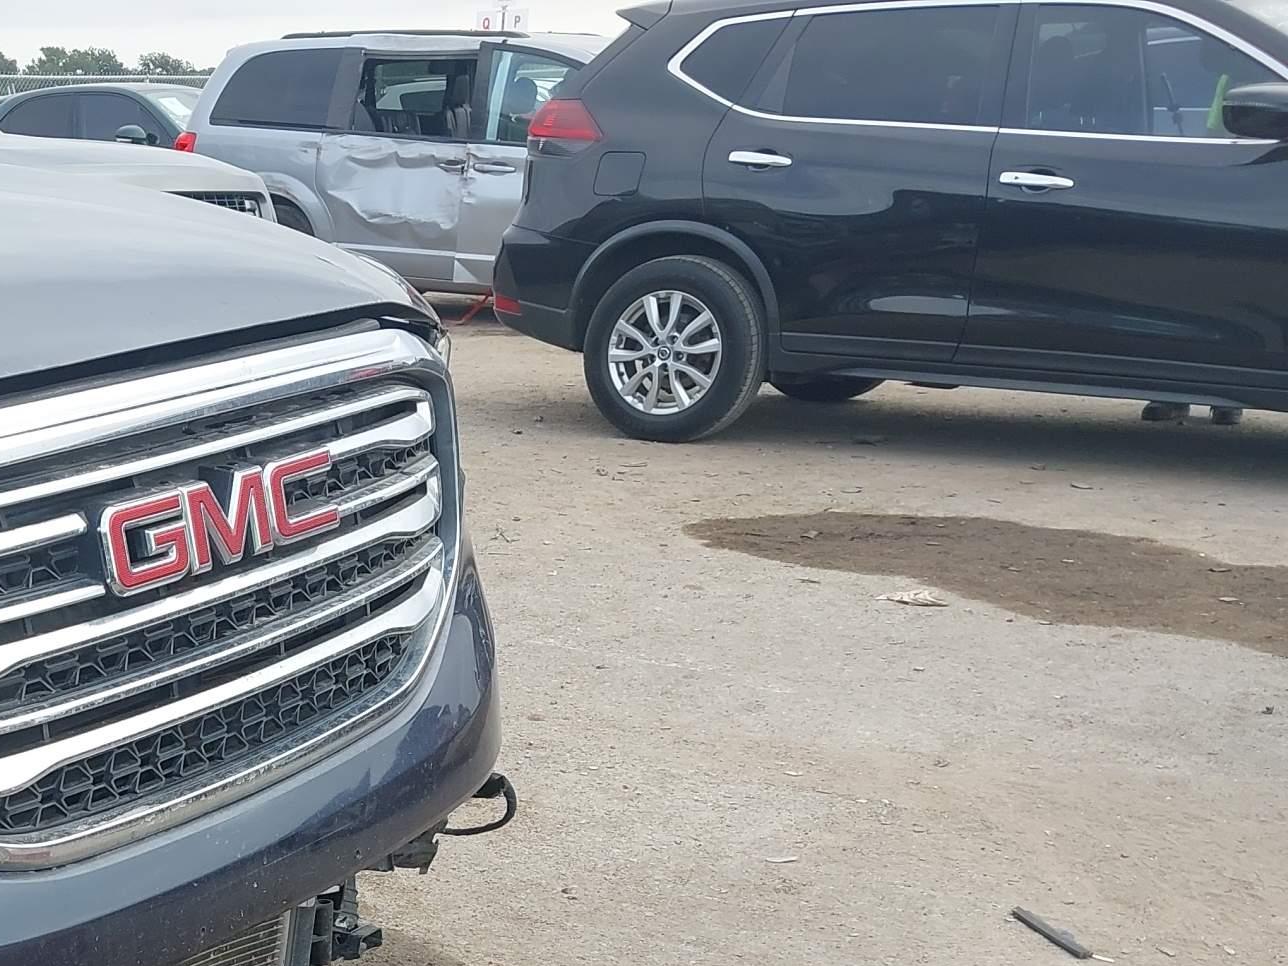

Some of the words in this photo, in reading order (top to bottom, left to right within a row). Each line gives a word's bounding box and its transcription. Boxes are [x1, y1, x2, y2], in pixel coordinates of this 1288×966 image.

[482, 17, 490, 30] Q
[514, 15, 521, 28] P
[98, 445, 340, 597] GMC
